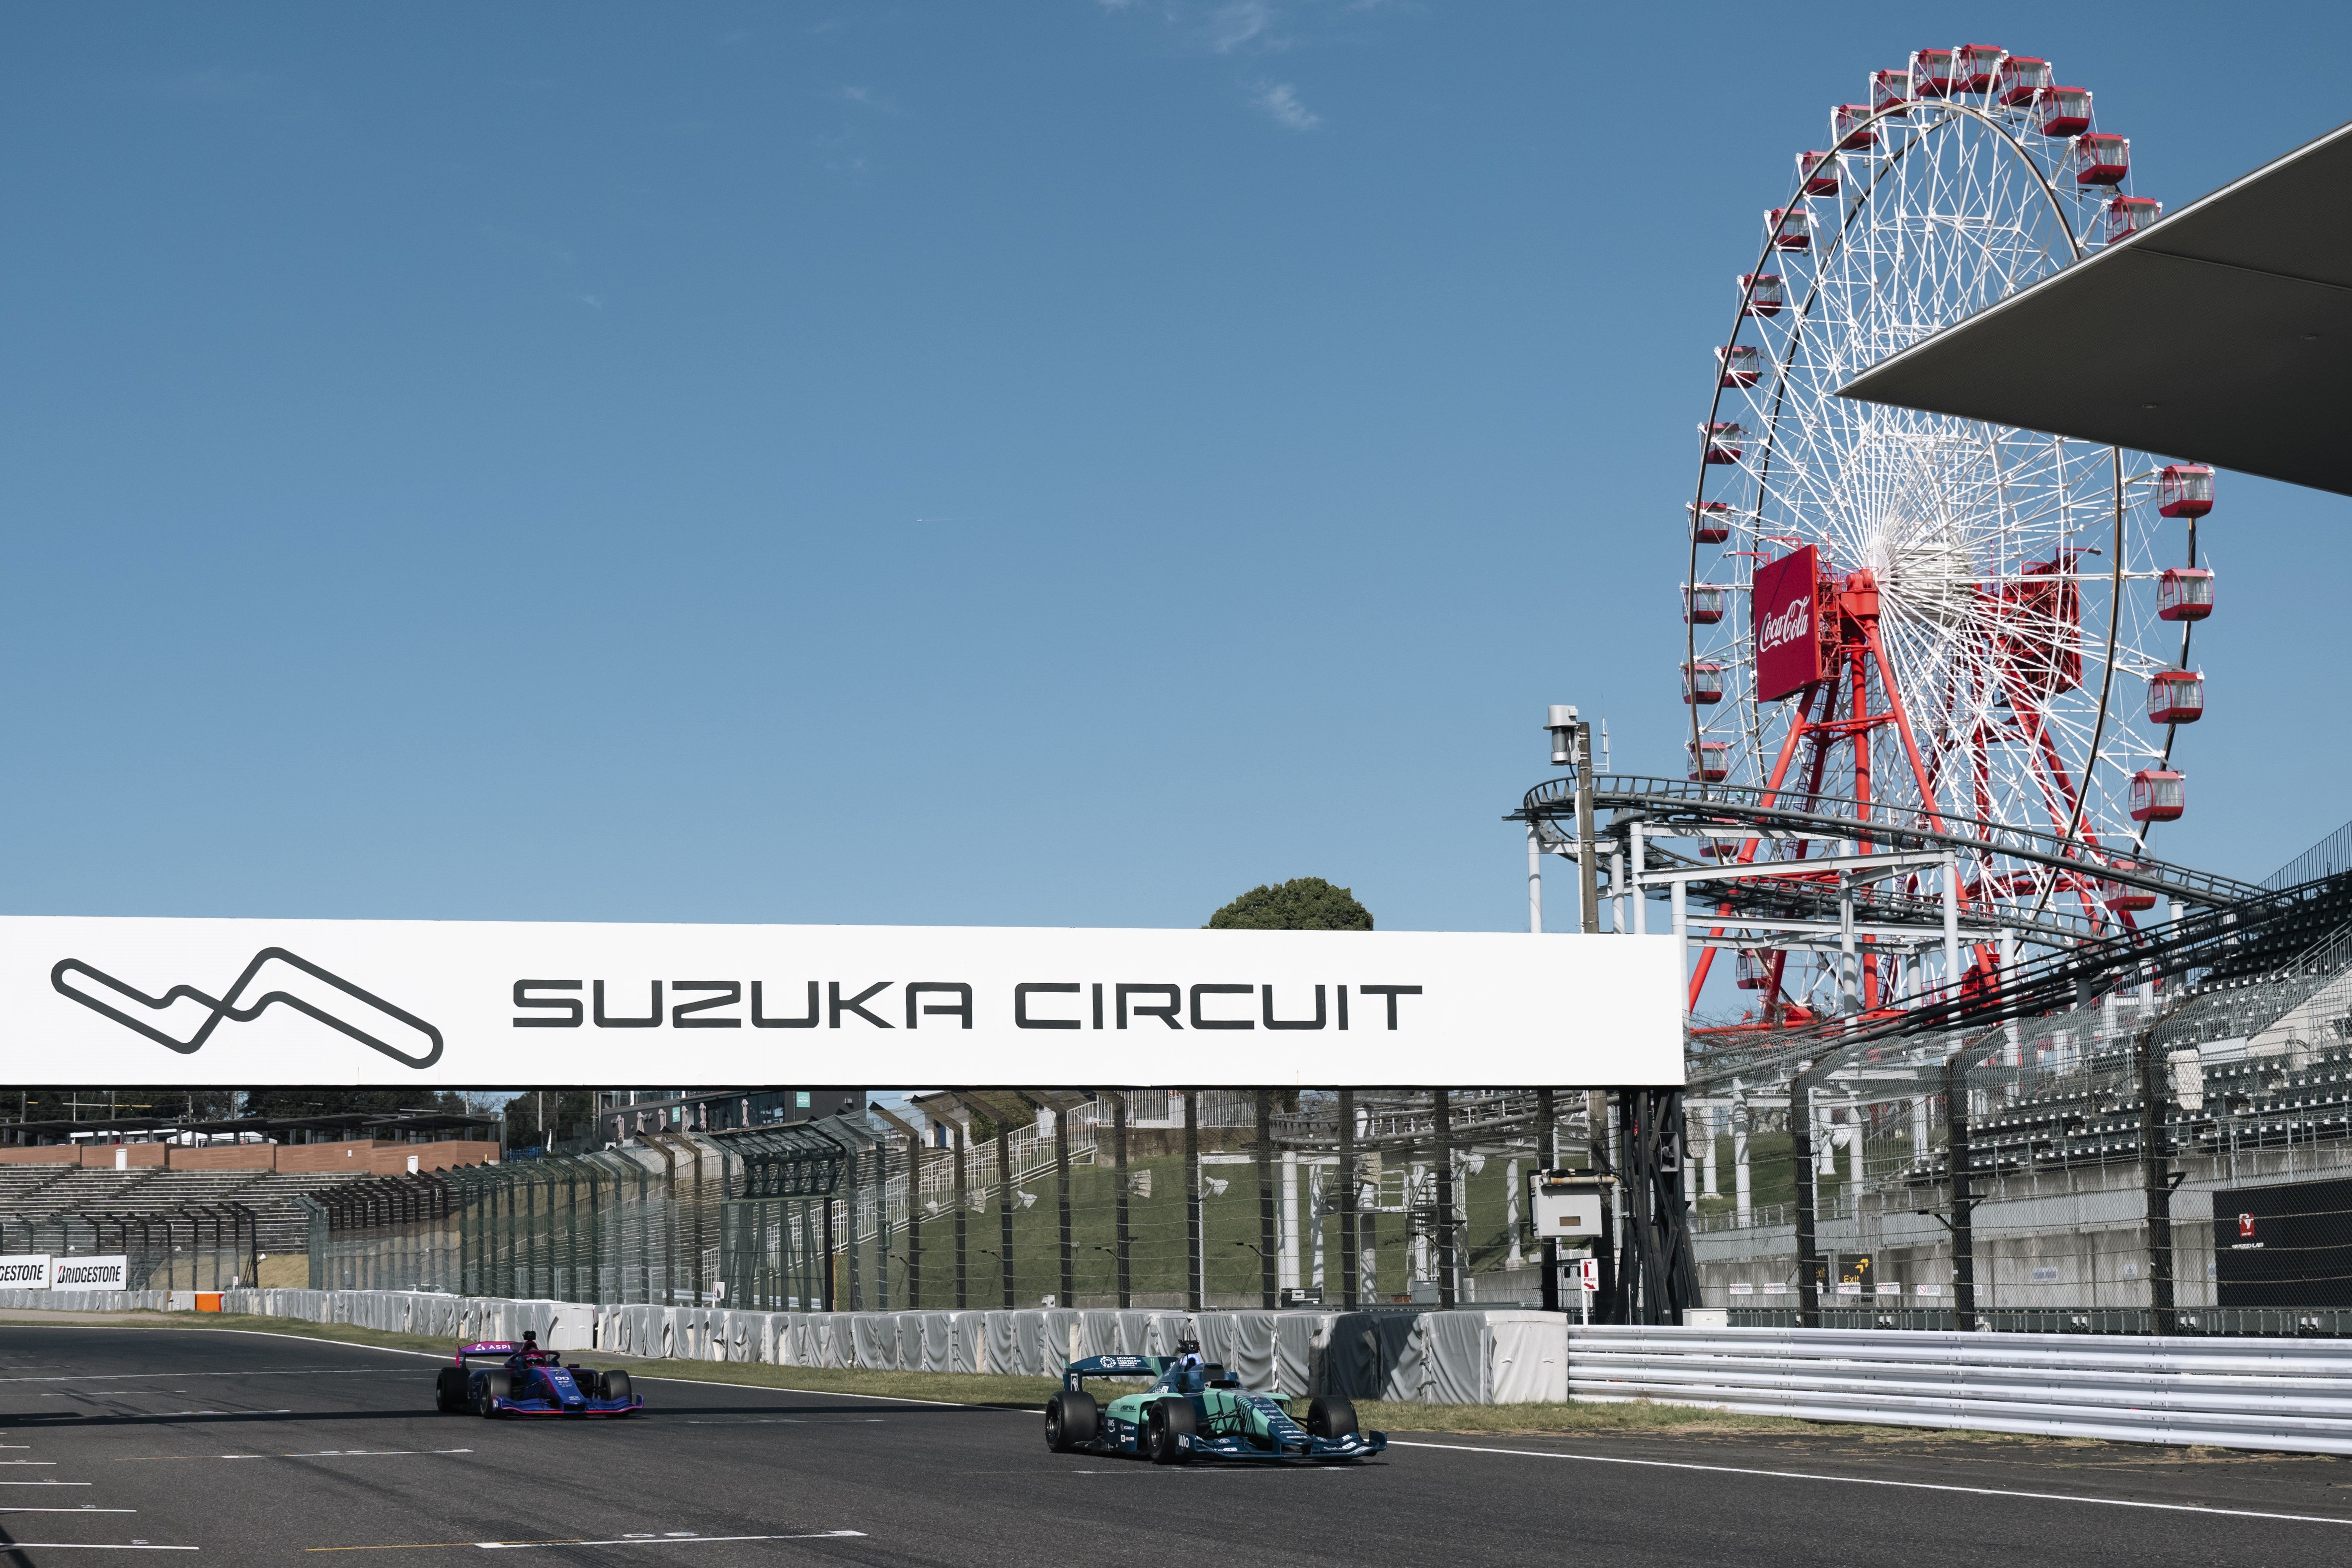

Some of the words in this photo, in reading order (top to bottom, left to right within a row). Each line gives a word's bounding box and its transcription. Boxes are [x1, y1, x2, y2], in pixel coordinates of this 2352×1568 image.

[1759, 594, 1811, 652] Coca-Cola
[513, 979, 973, 1029] SUZUKA
[1015, 983, 1422, 1030] CIRCUIT
[57, 1265, 121, 1284] BRIDGESTONE
